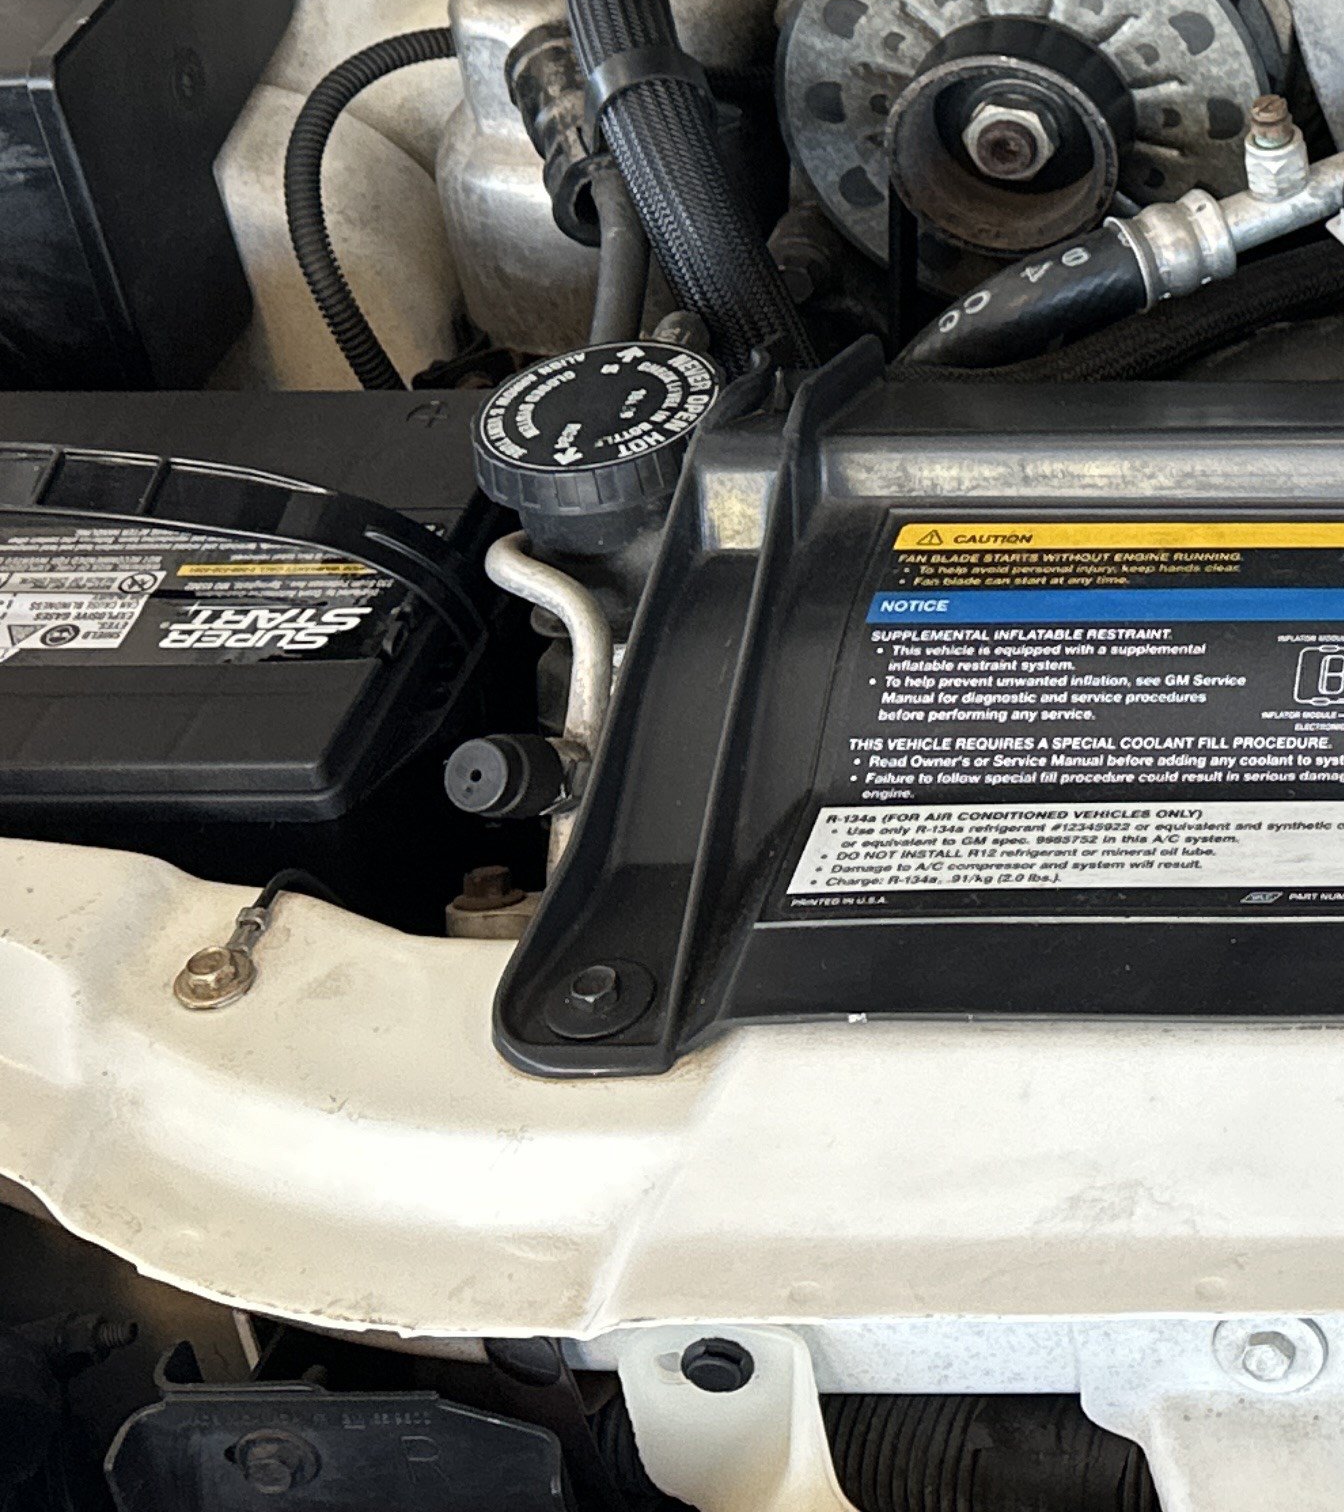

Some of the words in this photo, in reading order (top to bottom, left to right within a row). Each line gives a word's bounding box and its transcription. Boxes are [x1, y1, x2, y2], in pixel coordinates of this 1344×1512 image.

[667, 353, 713, 391] NEVER
[664, 394, 711, 432] OPEN
[617, 431, 667, 458] HOT
[953, 534, 1033, 544] CAUTION
[897, 554, 928, 563] FAN
[930, 553, 979, 563] BLADE
[983, 553, 1039, 563] STARTS
[1042, 553, 1110, 562] WITHOUT
[1113, 552, 1169, 562] ENGINE
[1173, 552, 1241, 561] RUNNING.
[880, 599, 949, 612] NOTICE
[169, 605, 373, 630] START
[158, 628, 341, 651] SUPER
[871, 629, 989, 642] SUPPLEMENTAL
[993, 628, 1084, 640] INFLATABLE
[1086, 628, 1171, 640] RESTRAINT.
[892, 644, 922, 656] This
[925, 645, 975, 656] vehicle
[977, 646, 991, 656] is
[994, 644, 1062, 657] equipped
[1064, 644, 1095, 655] with
[1096, 645, 1107, 655] a
[1110, 643, 1207, 656] supplemental
[885, 674, 902, 688] To
[904, 675, 936, 689] help
[938, 676, 993, 688] prevent
[996, 675, 1068, 686] unwanted
[1070, 674, 1131, 686] inflation,
[1135, 676, 1162, 686] see
[1164, 674, 1191, 686] GM
[1193, 674, 1247, 686] Service
[881, 692, 935, 704] Manual
[937, 691, 959, 704] for
[961, 692, 1036, 705] diagnostic
[1040, 691, 1068, 703] and
[1071, 693, 1123, 703] service
[1125, 692, 1207, 704] procedures
[849, 737, 884, 751] THIS
[887, 737, 952, 751] VEHICLE
[955, 737, 1035, 750] REQUIRES
[1036, 737, 1049, 749] A
[1052, 736, 1116, 750] SPECIAL
[1120, 736, 1195, 750] COOLANT
[1197, 736, 1229, 749] FILL
[1232, 736, 1331, 749] PROCEDURE.
[868, 755, 908, 767] Read
[910, 754, 971, 767] Owner's
[973, 757, 991, 767] or
[993, 754, 1047, 767] Service
[1050, 754, 1104, 767] Manual
[1106, 754, 1154, 767] before
[1157, 754, 1207, 769] adding
[1209, 756, 1237, 768] any
[1239, 754, 1294, 766] coolant
[1296, 754, 1313, 766] to
